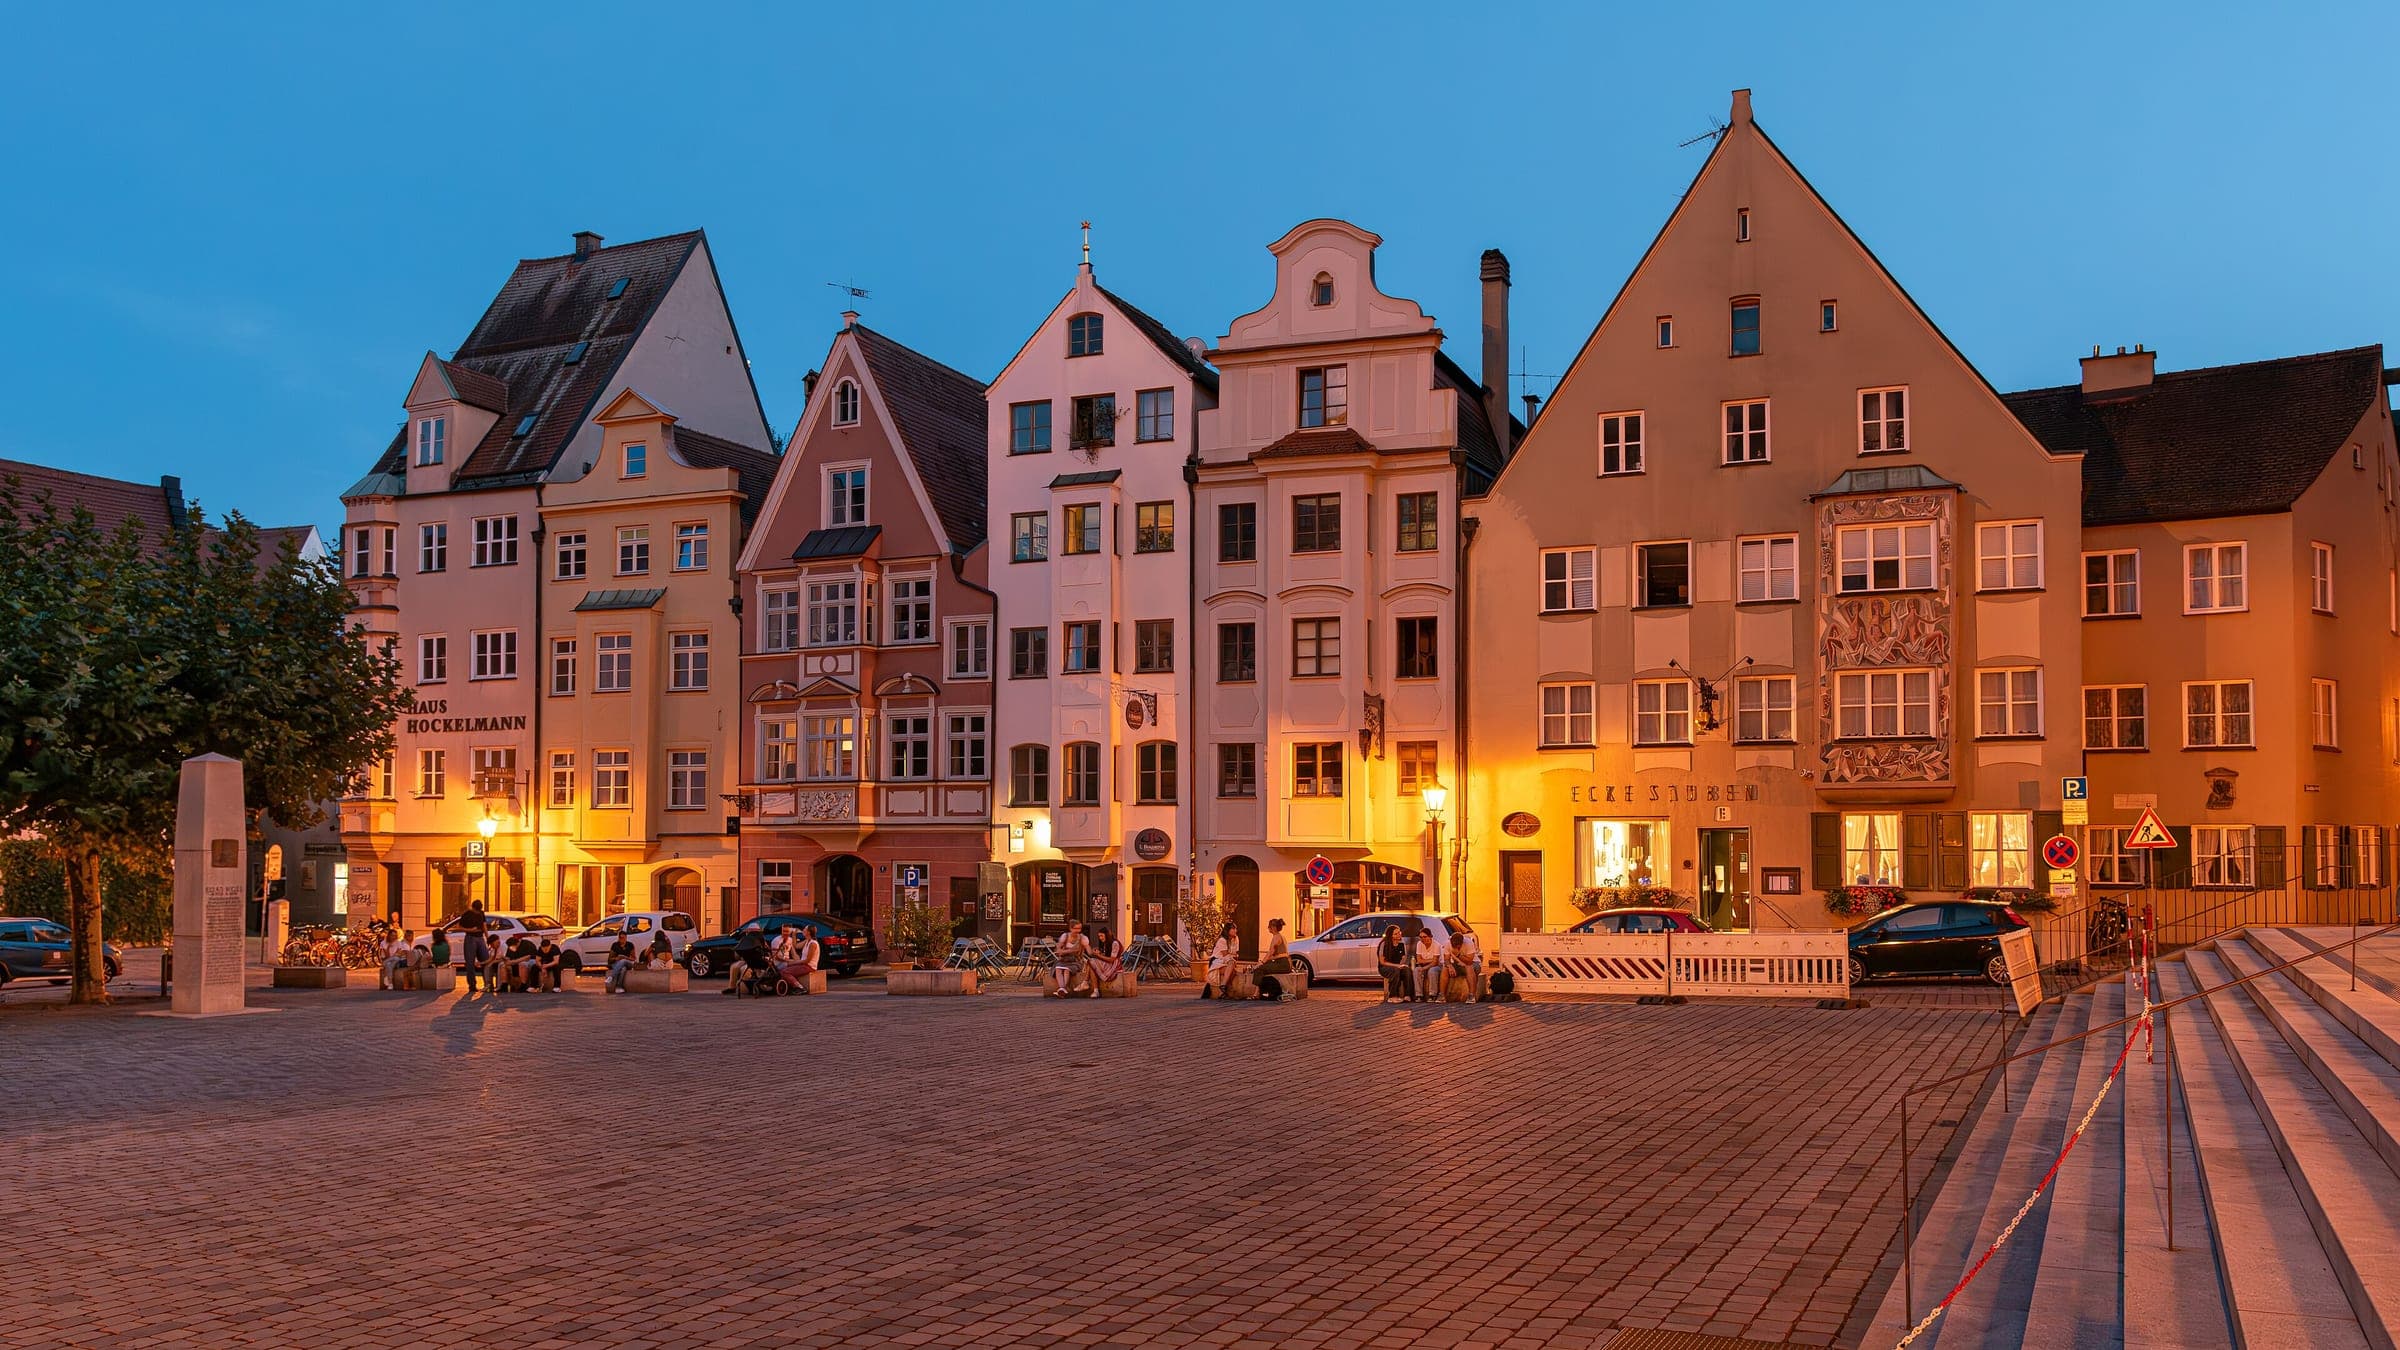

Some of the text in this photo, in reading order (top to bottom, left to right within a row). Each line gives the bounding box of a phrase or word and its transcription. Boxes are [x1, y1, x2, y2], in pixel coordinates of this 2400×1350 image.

[407, 700, 447, 714] HAUS
[407, 716, 526, 733] HOCKELMANN
[1571, 785, 1633, 802] ECKE
[2066, 780, 2080, 797] P
[907, 872, 916, 885] P
